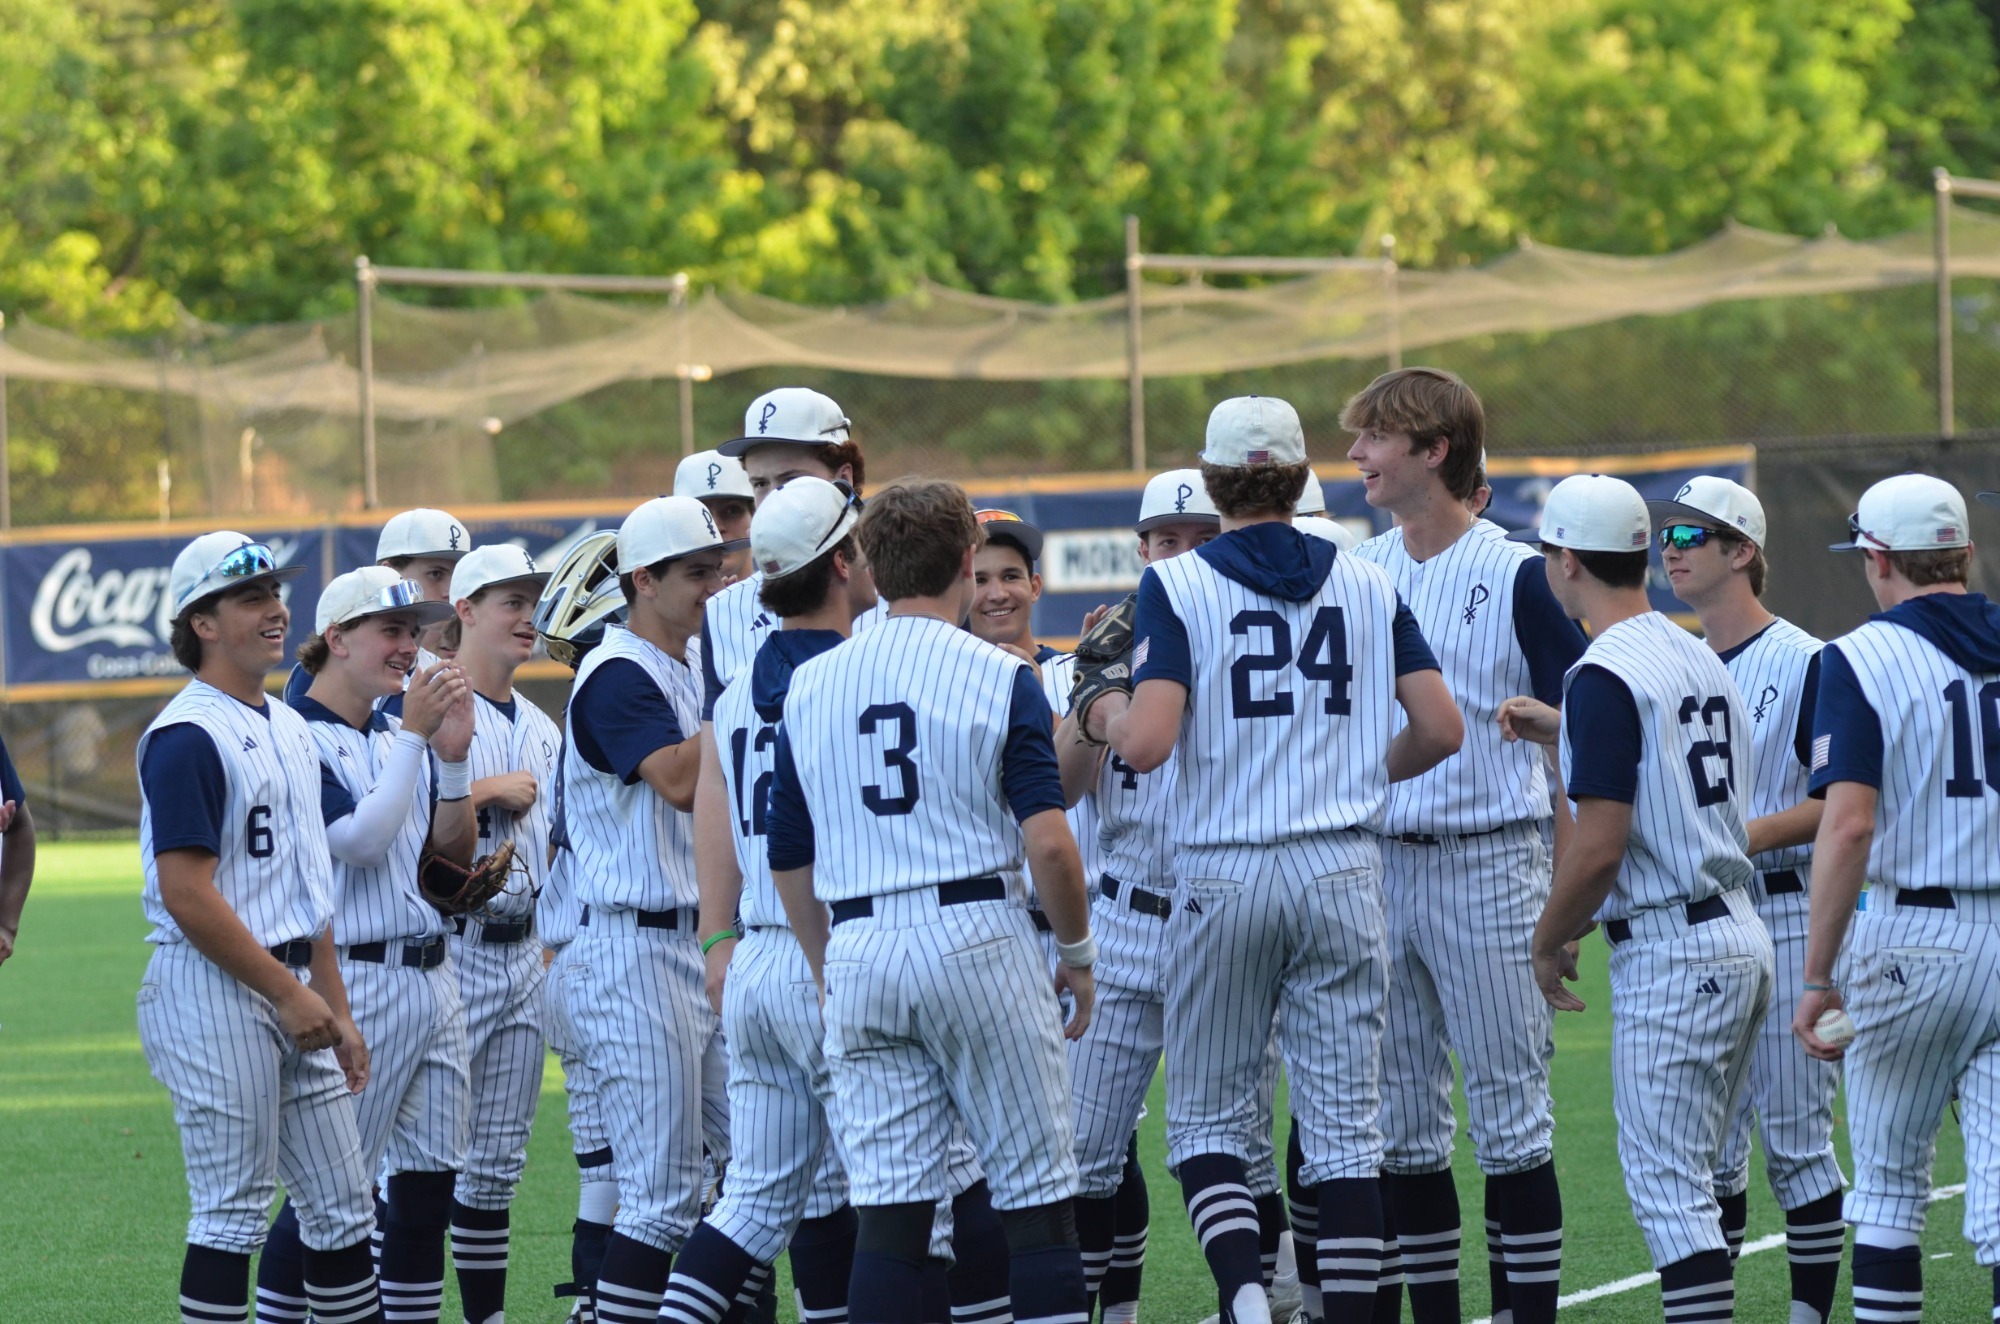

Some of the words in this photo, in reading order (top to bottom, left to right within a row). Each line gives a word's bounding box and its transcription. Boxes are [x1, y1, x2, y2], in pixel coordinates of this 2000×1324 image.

[1229, 606, 1353, 719] 24
[859, 701, 920, 817] 3
[247, 805, 274, 859] 6
